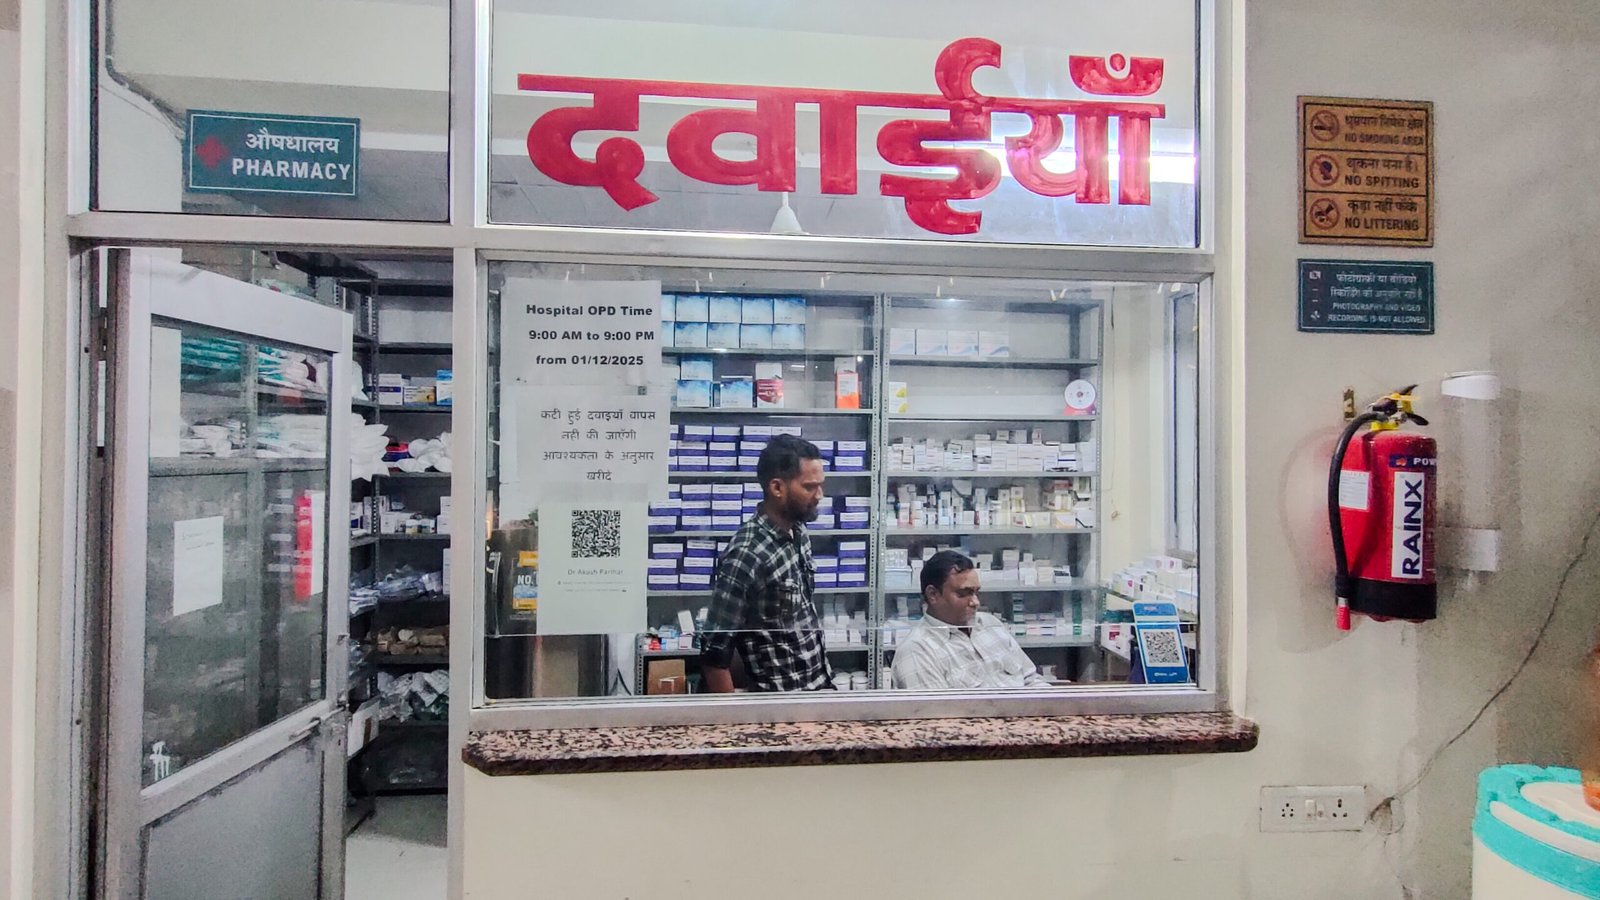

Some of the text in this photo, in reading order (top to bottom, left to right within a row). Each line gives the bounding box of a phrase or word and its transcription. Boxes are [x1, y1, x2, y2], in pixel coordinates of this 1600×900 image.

[245, 127, 340, 154] औषधालय
[1345, 133, 1424, 146] NO SMOKING AREA
[232, 158, 351, 180] PHARMACY
[1344, 175, 1419, 188] NO SPITTING
[1344, 217, 1419, 231] NO LITTERING
[526, 304, 653, 317] Hospital OPD Time
[528, 330, 655, 341] 9:00 AM to 9:00 PM
[536, 355, 644, 366] from 01/12/2025
[540, 408, 561, 419] कटी
[629, 411, 656, 420] वापस
[586, 428, 599, 440] की
[543, 450, 655, 464] आवश्यकता के अनुसार
[1402, 480, 1423, 575] RAINX
